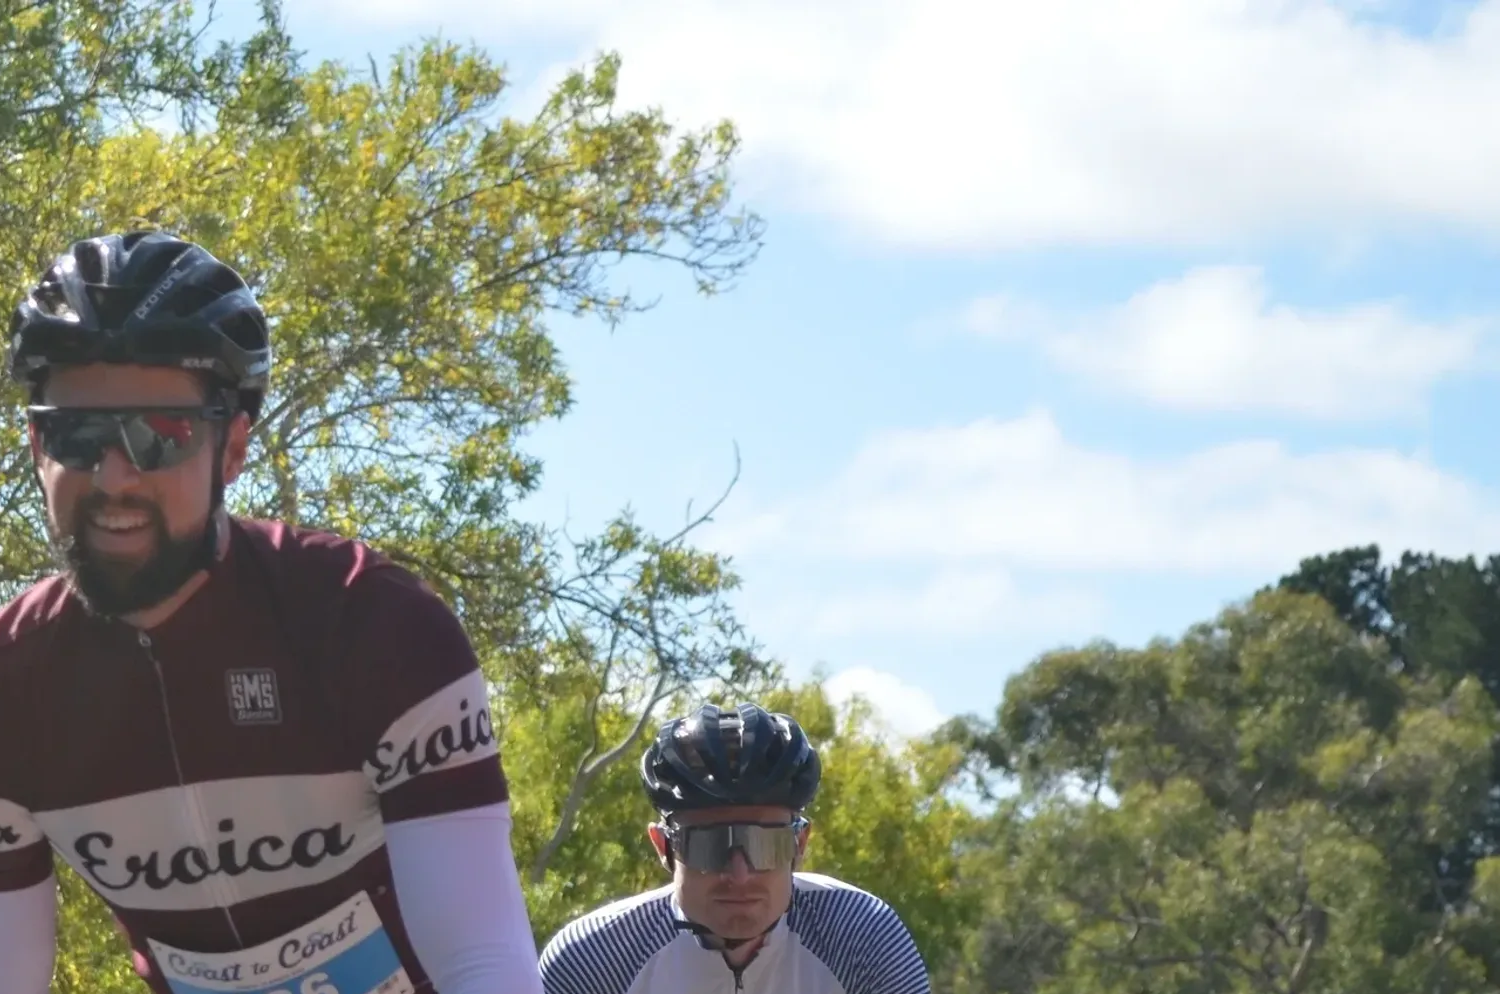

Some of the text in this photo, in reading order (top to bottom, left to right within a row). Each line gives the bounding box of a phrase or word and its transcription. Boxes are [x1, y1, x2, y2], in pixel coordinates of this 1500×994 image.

[230, 673, 275, 710] SMS
[73, 818, 355, 892] Eroica
[168, 953, 243, 983] Coast
[252, 962, 271, 976] to
[278, 910, 358, 969] Coast
